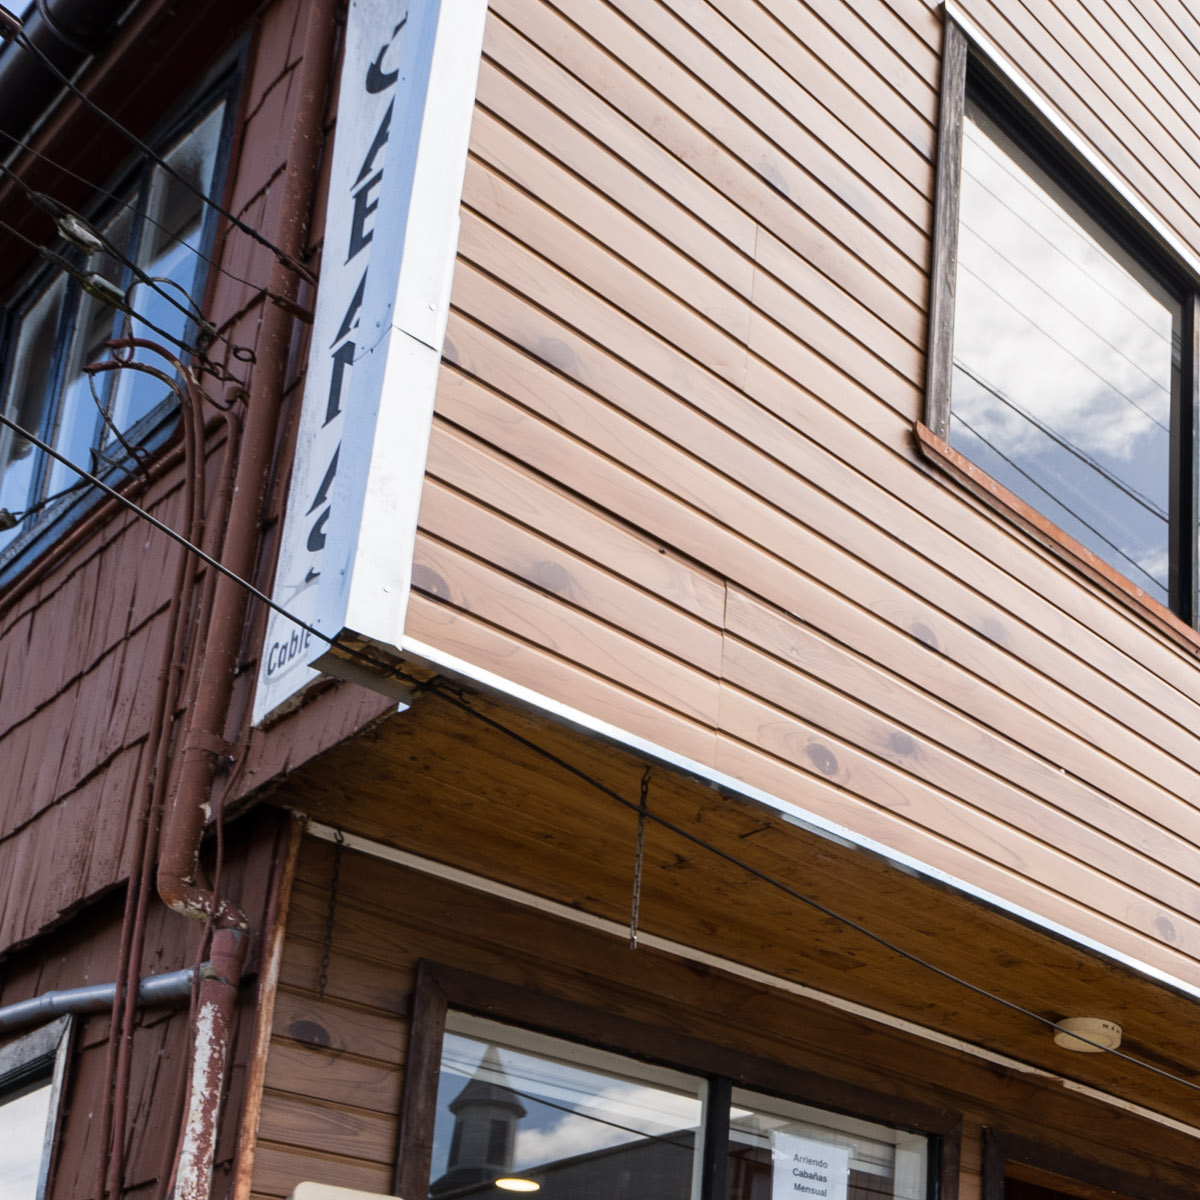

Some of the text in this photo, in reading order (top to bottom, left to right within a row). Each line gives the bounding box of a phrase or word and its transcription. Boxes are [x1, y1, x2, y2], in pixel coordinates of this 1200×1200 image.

[792, 1153, 829, 1170] Arriendo
[792, 1167, 828, 1183] Cabañas
[793, 1182, 828, 1198] Mensual
